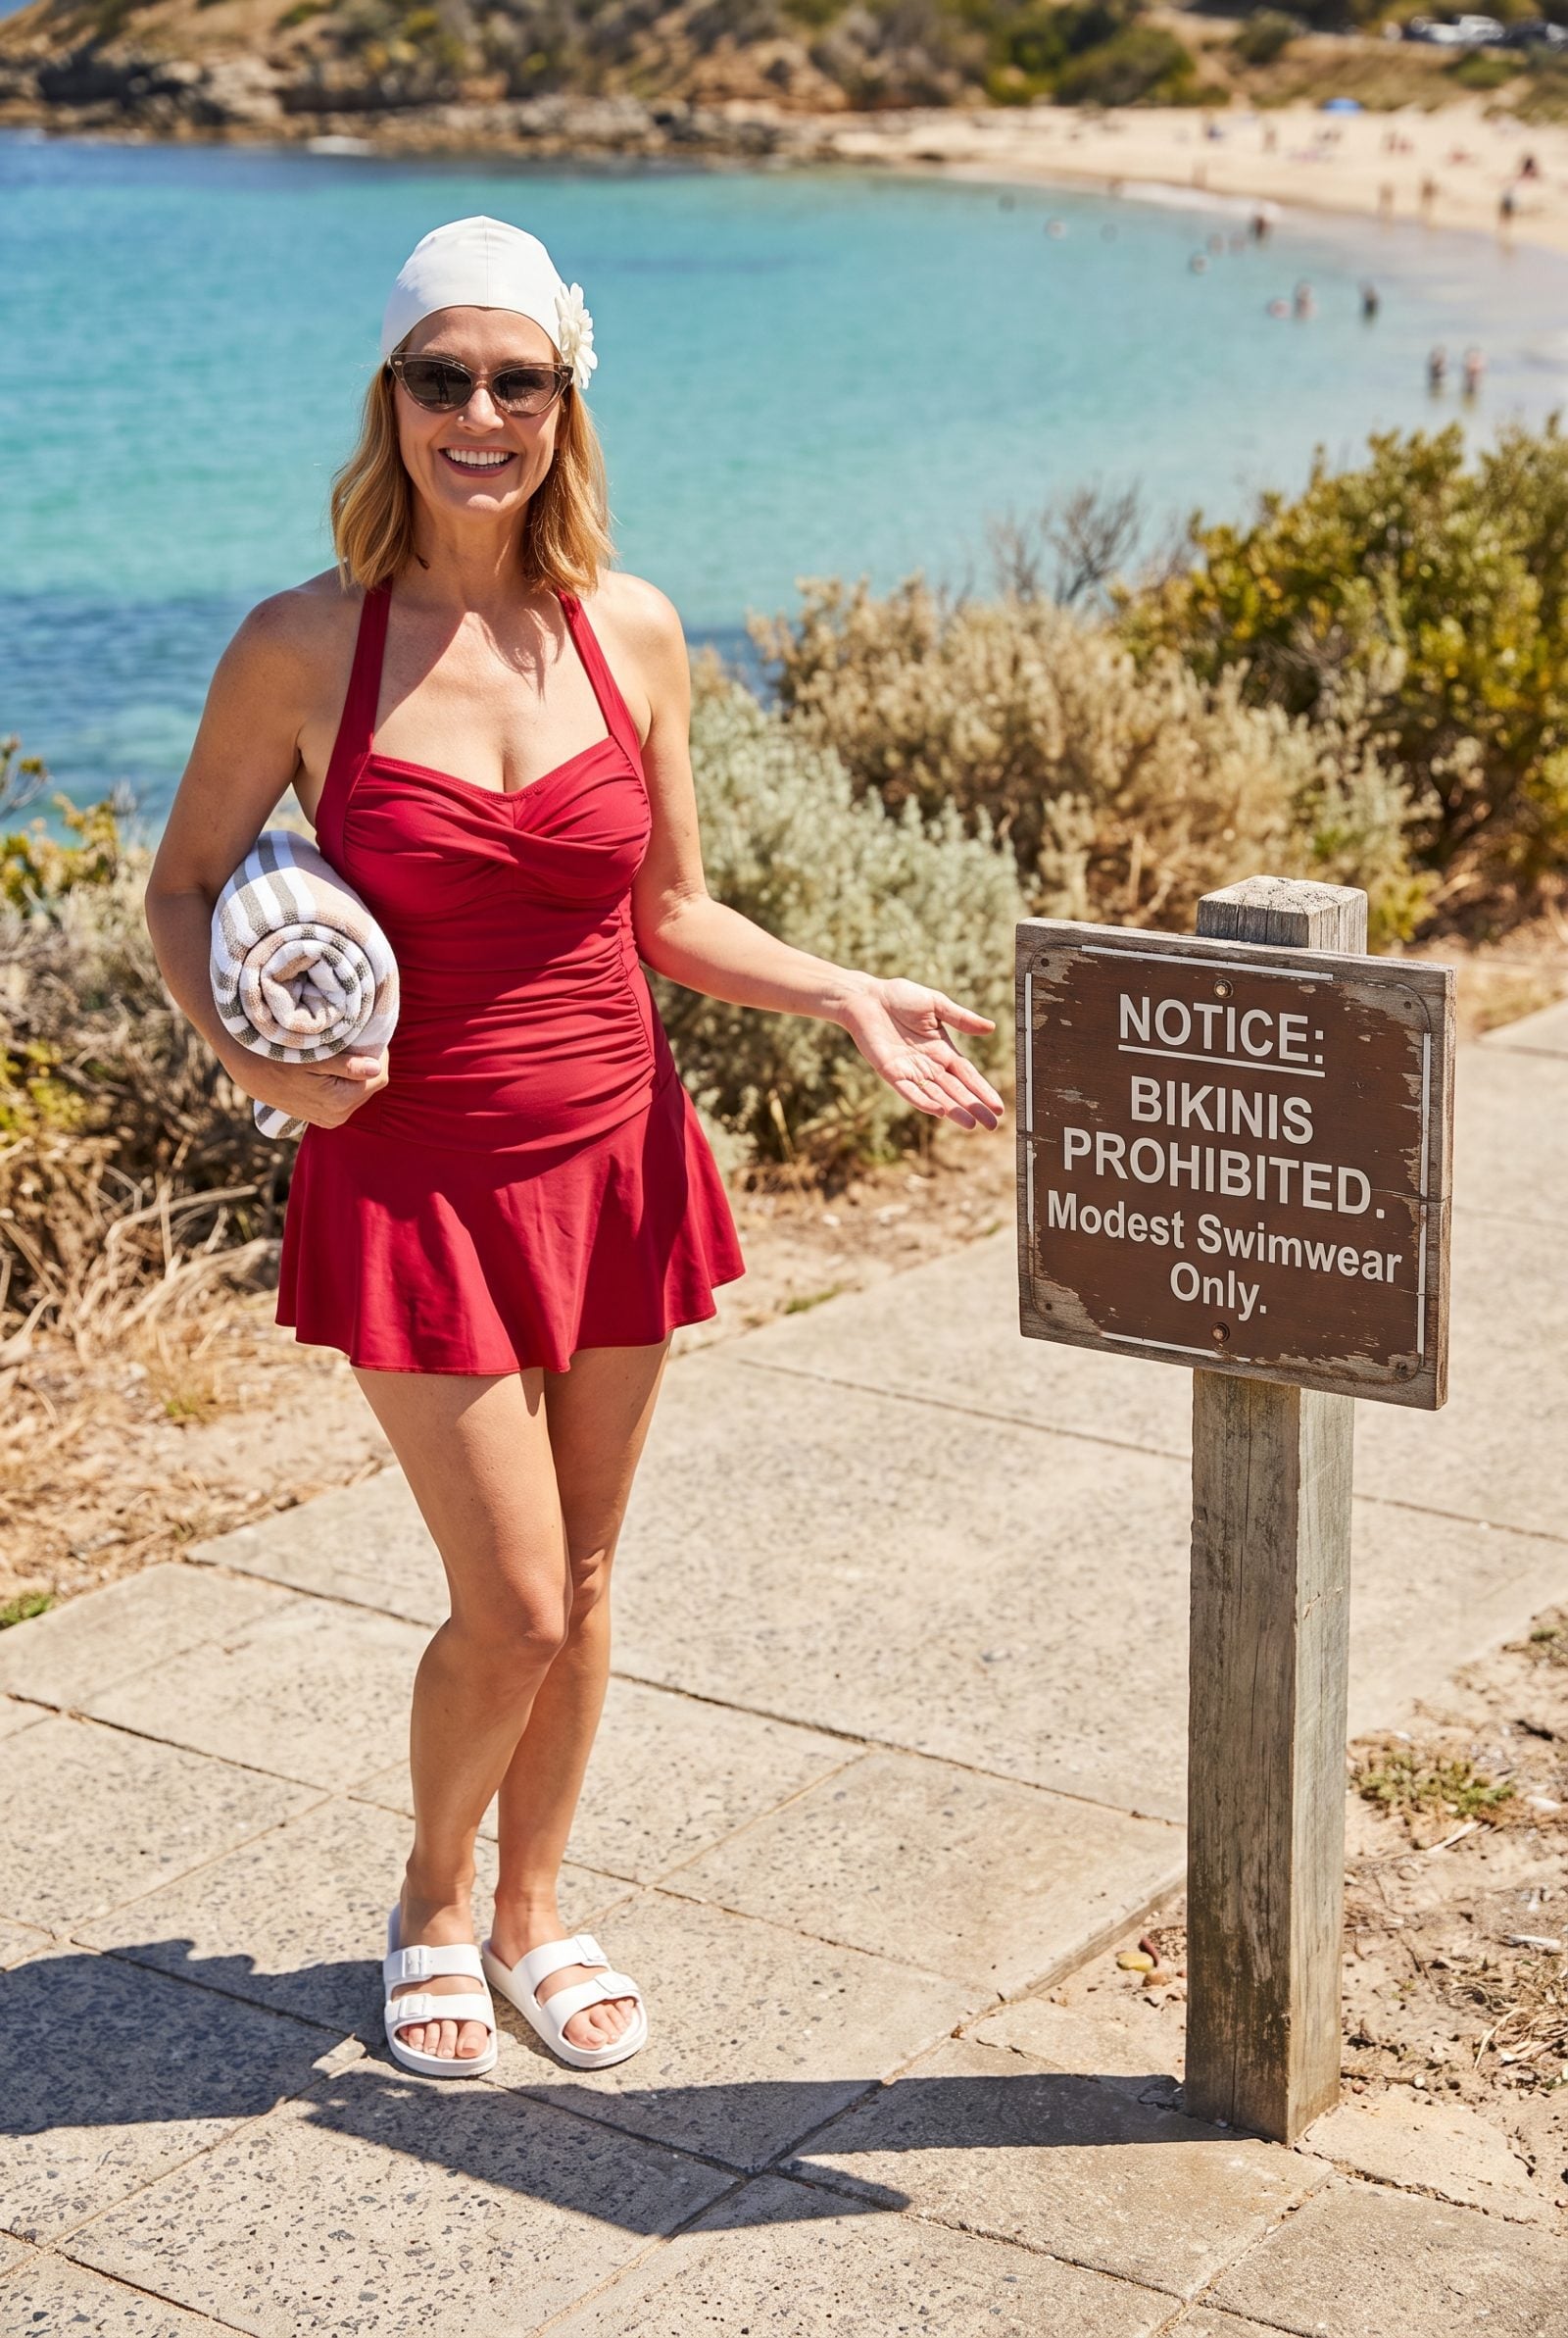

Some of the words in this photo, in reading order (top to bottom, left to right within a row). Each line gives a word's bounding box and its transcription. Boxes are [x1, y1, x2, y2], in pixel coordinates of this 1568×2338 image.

[1119, 993, 1325, 1066] NOTICE:
[1130, 1075, 1314, 1145] BIKINIS
[1063, 1126, 1386, 1219] PROHIBITED.
[1048, 1190, 1185, 1249] Modest
[1197, 1214, 1402, 1283] Swimwear
[1169, 1262, 1268, 1321] Only.
